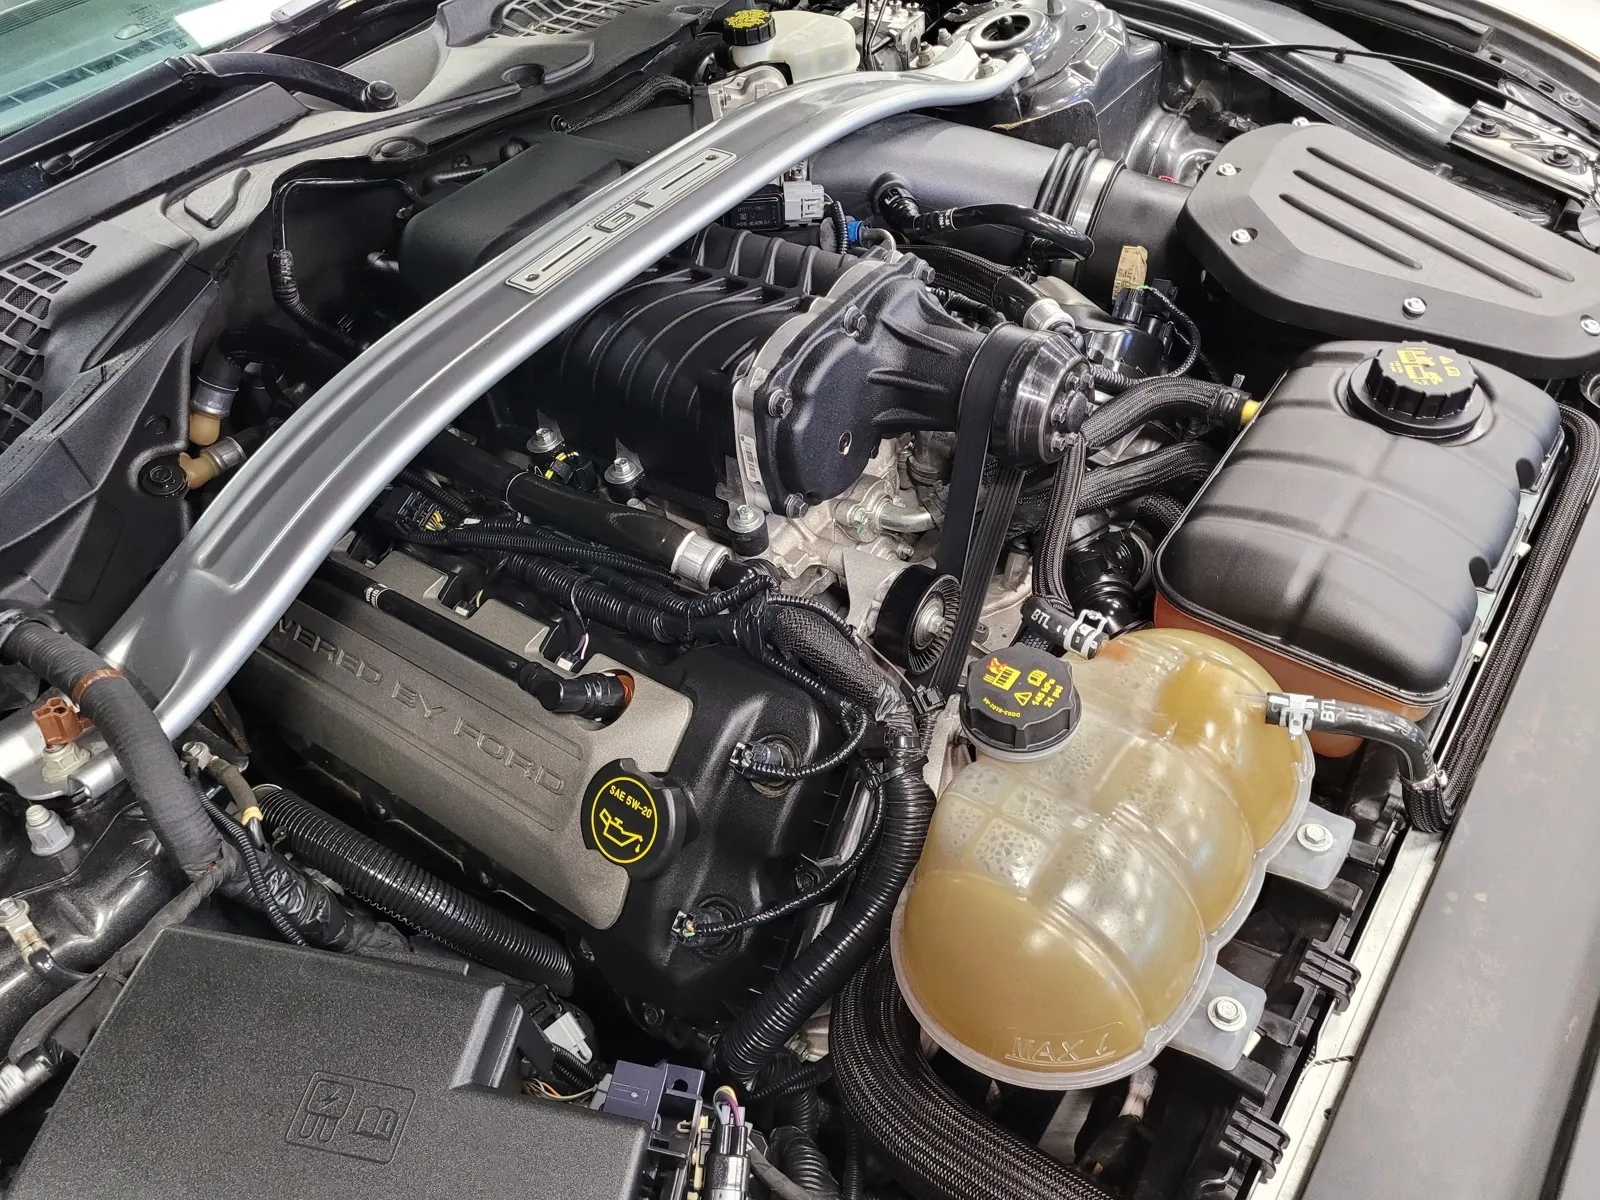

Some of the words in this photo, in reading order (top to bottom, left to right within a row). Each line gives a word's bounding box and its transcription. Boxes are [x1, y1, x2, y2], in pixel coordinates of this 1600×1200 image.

[593, 190, 656, 233] GT
[1031, 608, 1050, 629] BTL
[1320, 699, 1336, 723] BTL
[391, 681, 447, 719] BY
[453, 717, 565, 795] FORD
[609, 785, 626, 802] SAE
[625, 795, 653, 819] 5W-20
[1011, 1036, 1084, 1061] MAX
